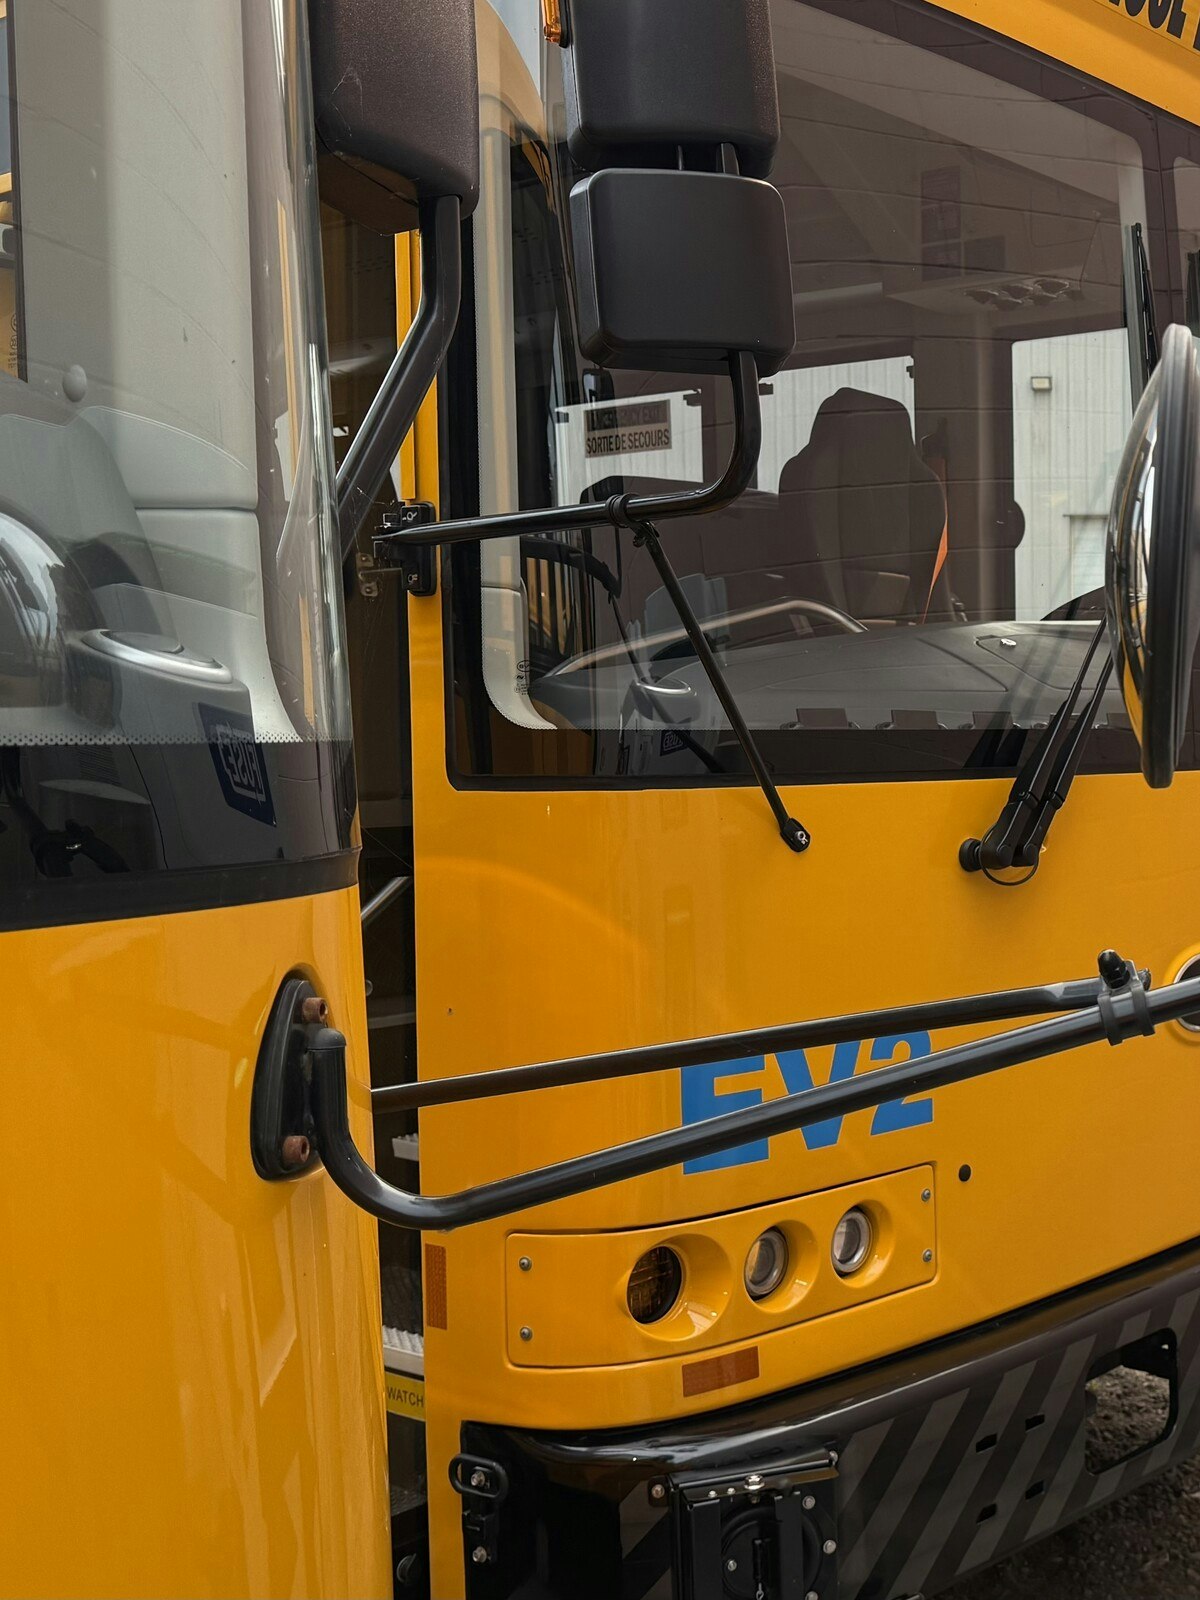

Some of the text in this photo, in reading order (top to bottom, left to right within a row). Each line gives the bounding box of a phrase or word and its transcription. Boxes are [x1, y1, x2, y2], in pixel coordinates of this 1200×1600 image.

[586, 428, 670, 454] SORTIE DE SECOURS
[680, 1030, 934, 1175] EV2
[387, 1387, 424, 1408] WATCH
